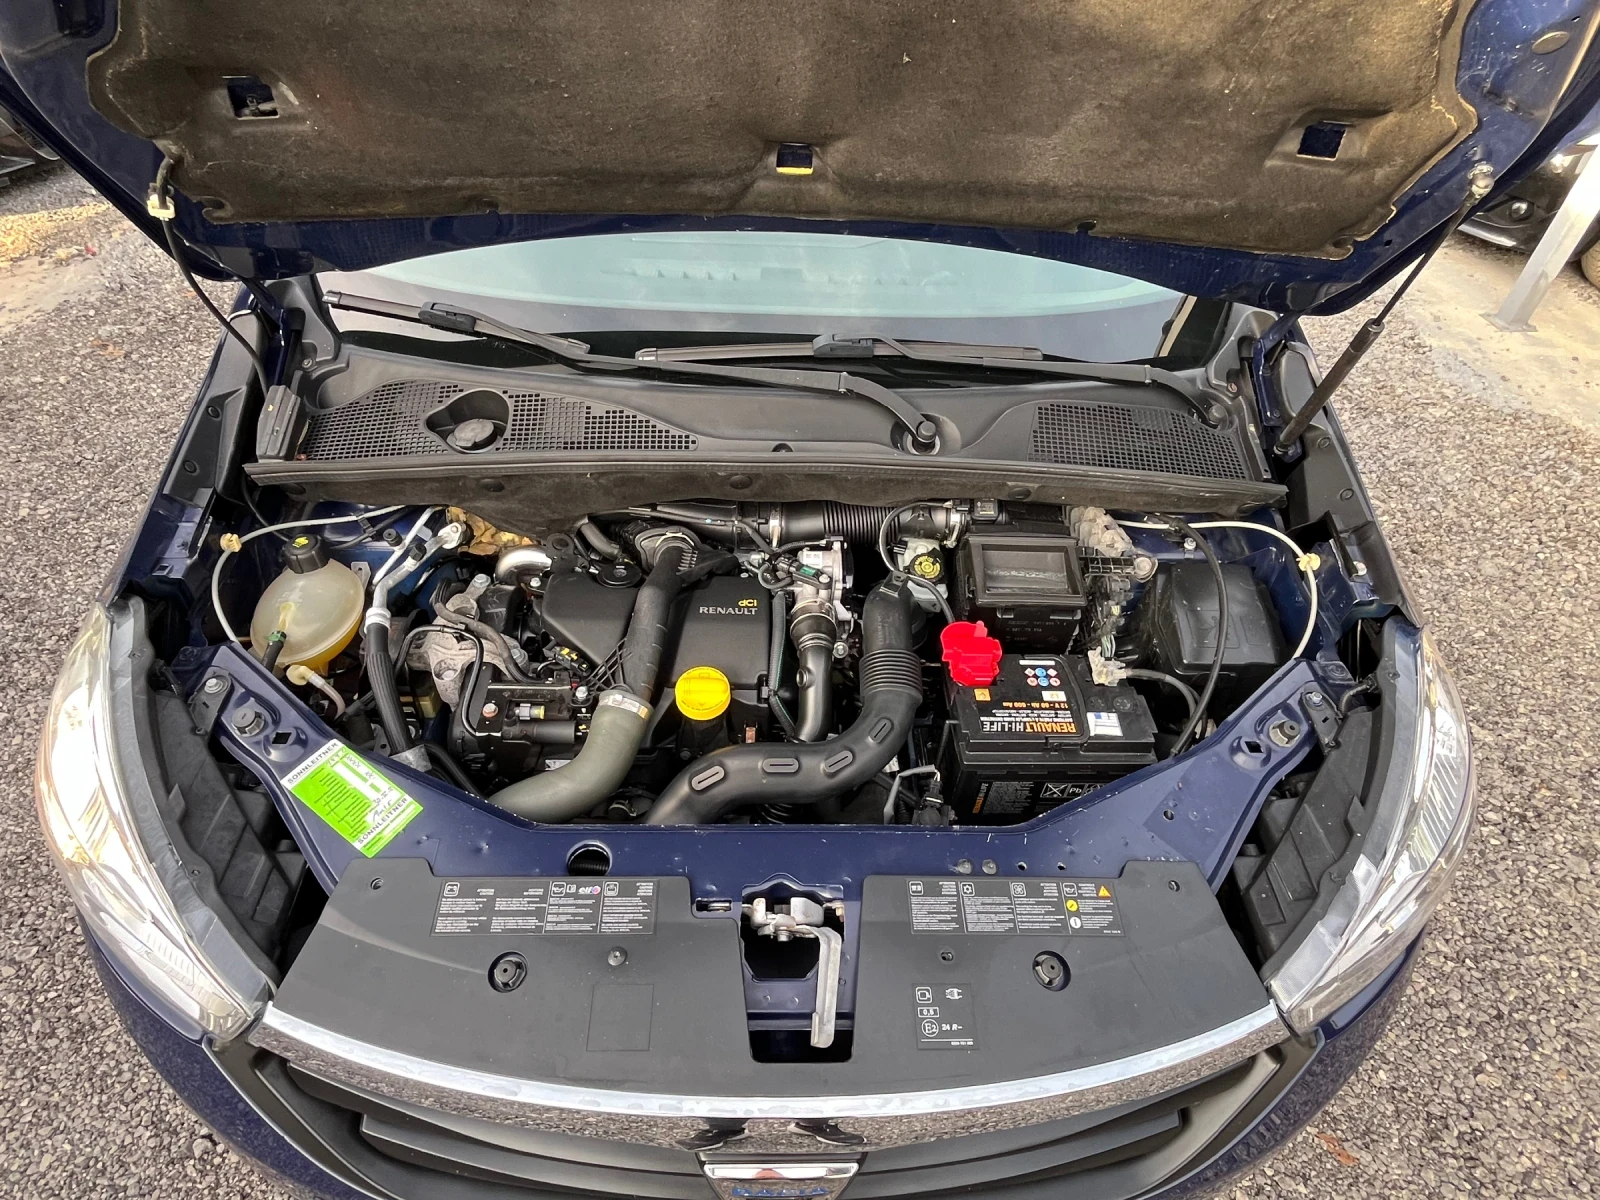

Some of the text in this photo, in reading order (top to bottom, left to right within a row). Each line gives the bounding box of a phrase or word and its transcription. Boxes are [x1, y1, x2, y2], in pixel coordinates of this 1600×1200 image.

[699, 606, 758, 615] RENAULT
[1025, 722, 1077, 733] RENAULT
[286, 742, 339, 784] SONNLEITNER
[356, 796, 409, 845] SONNLEITNER
[941, 1023, 950, 1031] 24
